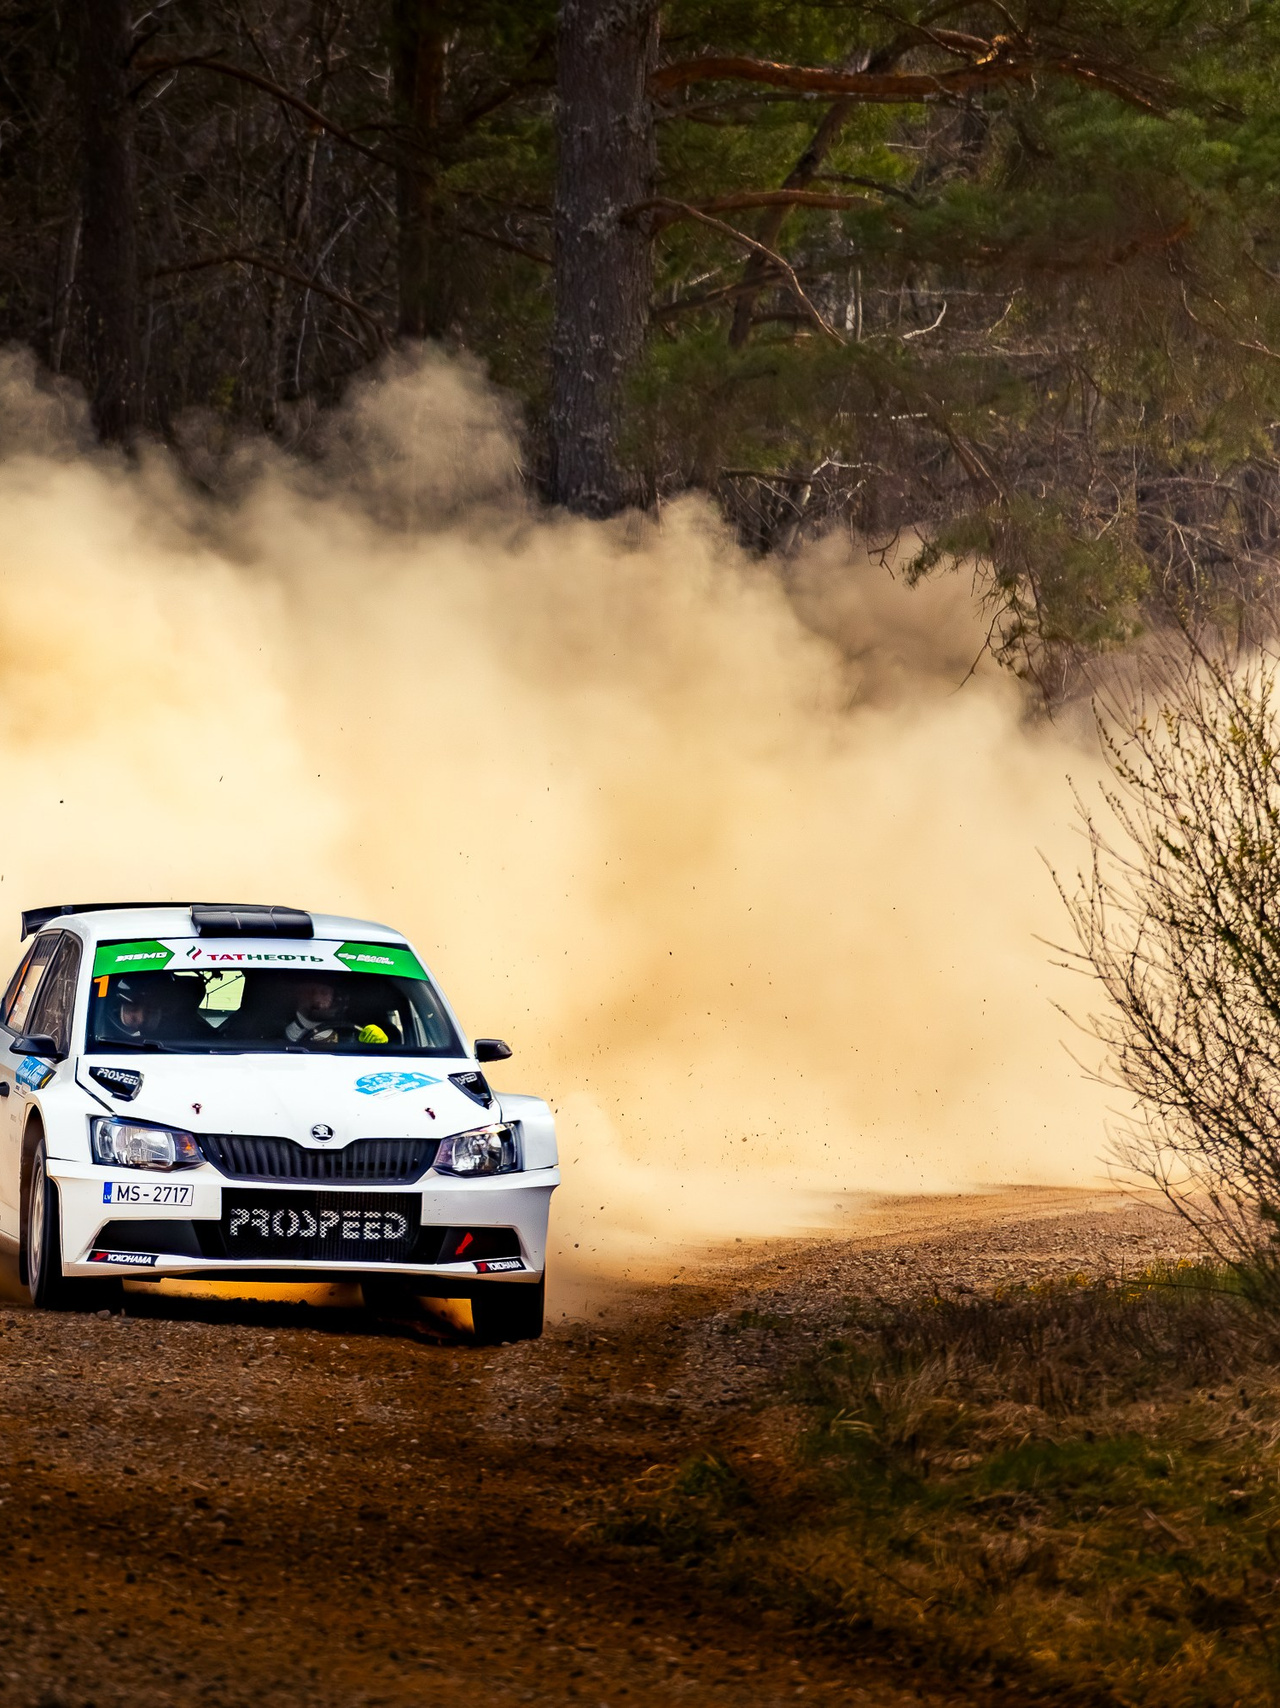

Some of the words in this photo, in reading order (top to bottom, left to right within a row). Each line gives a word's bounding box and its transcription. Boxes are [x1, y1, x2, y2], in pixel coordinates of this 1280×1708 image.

[207, 954, 324, 962] ТАТНЕФТЬ
[94, 975, 110, 997] 1
[97, 1067, 139, 1086] PROSPEED
[117, 1185, 189, 1203] MS-2717
[230, 1208, 407, 1240] PROSPEED
[107, 1254, 152, 1264] YOKOHAMA
